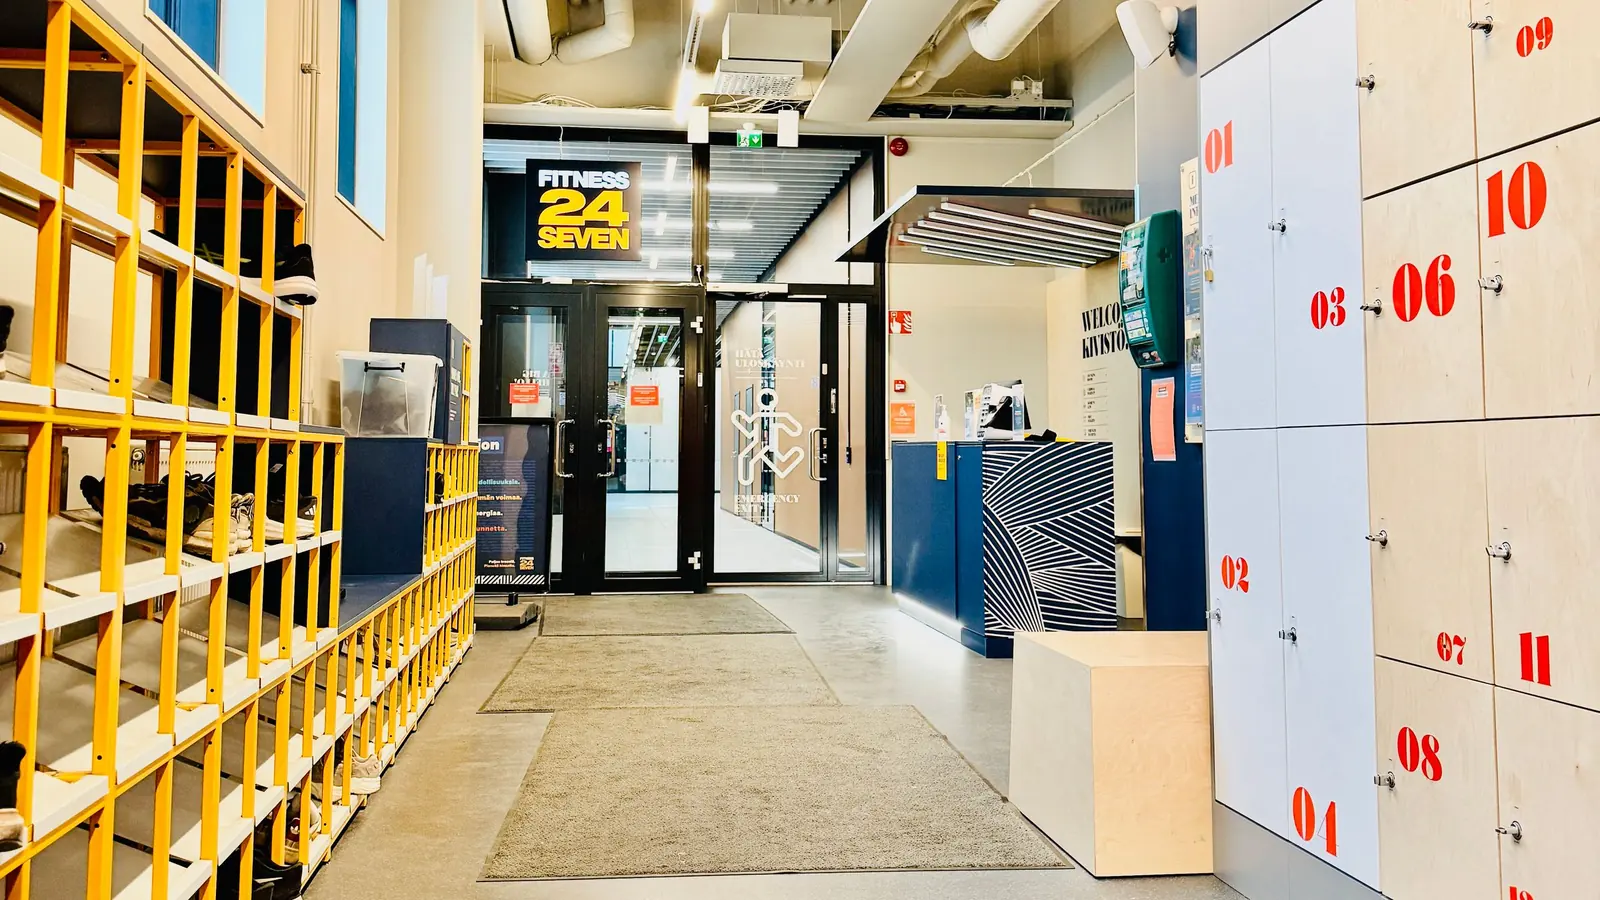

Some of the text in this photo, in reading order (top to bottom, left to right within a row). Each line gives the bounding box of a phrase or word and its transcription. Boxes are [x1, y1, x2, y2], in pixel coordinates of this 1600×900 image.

[1516, 16, 1553, 57] 09
[1205, 120, 1233, 173] 01
[538, 169, 630, 190] FITNESS
[1487, 161, 1547, 237] 10
[538, 189, 630, 227] 24
[537, 226, 630, 250] SEVEN
[1310, 286, 1346, 329] 03
[1393, 254, 1456, 322] 06
[1082, 302, 1123, 332] WELCO
[1221, 555, 1250, 593] 02
[1436, 631, 1466, 665] 07
[1519, 632, 1551, 687] 11
[1397, 726, 1443, 781] 08
[1292, 786, 1338, 857] 04
